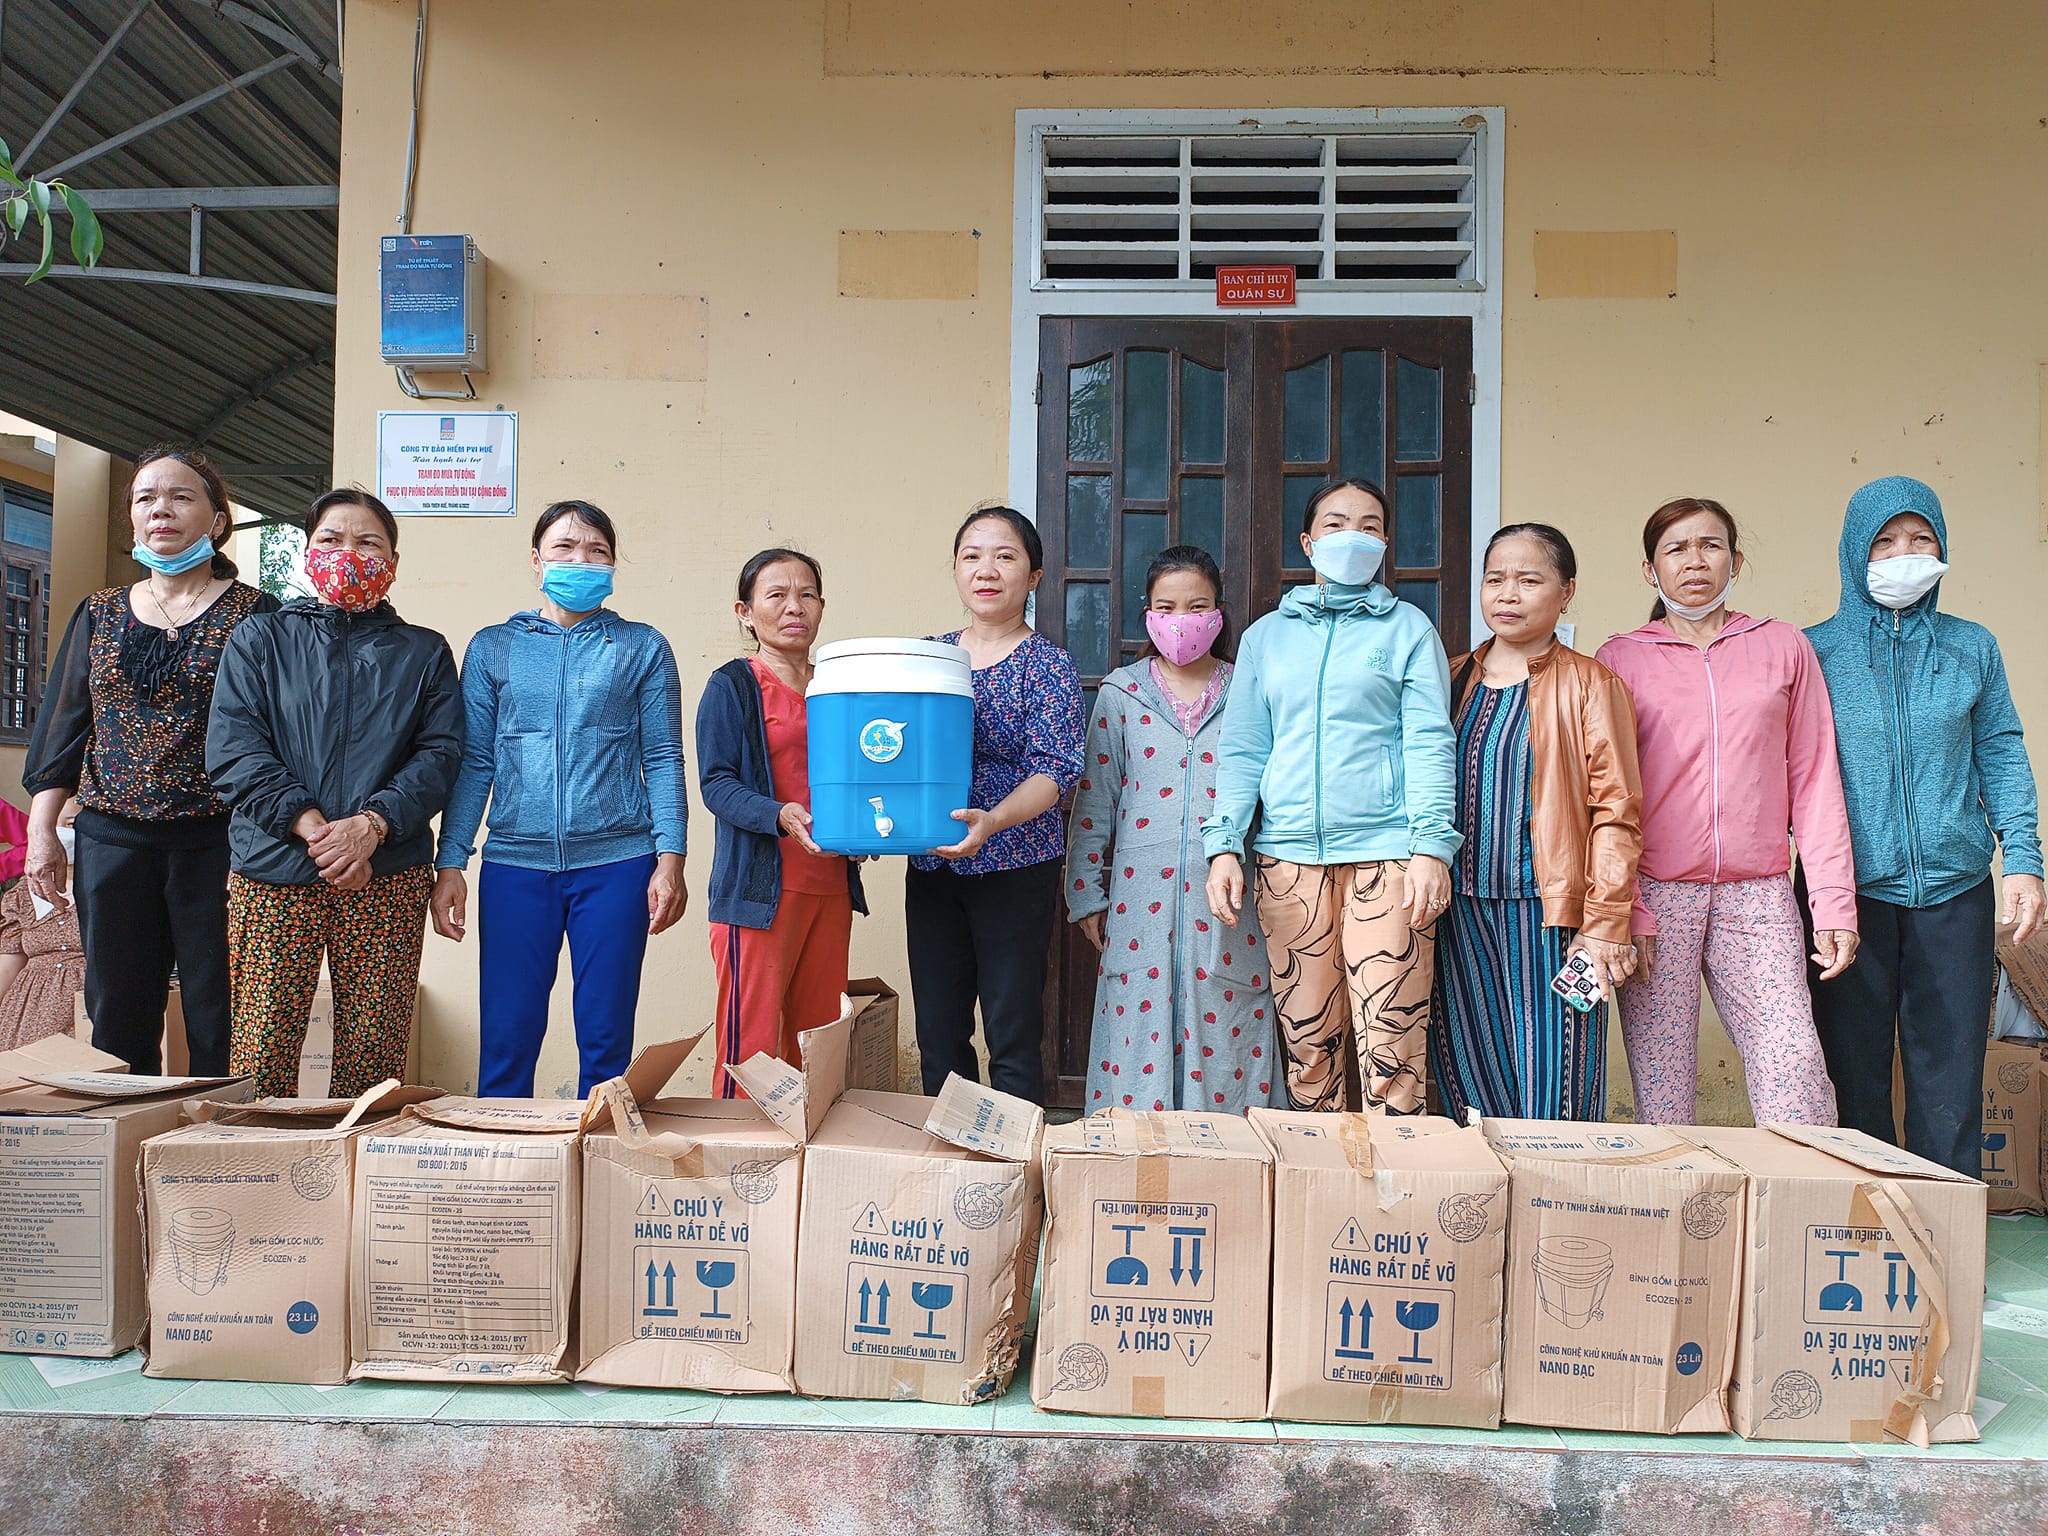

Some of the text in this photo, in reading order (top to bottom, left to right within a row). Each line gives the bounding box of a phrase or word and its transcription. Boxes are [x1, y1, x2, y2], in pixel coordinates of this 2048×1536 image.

[1224, 272, 1288, 284] BAN CHỈ HUY
[1227, 288, 1285, 299] QUÂN SỰ
[401, 445, 419, 453] CÔNG
[1987, 1088, 1995, 1103] Ý
[7, 1125, 40, 1137] THAN VIỆT
[5, 1139, 20, 1147] 2015
[367, 1142, 490, 1159] CÔNG TY TNHH SẢN XUẤT THAN VIỆT
[417, 1160, 428, 1168] ISO
[450, 1161, 467, 1170] 2015
[674, 1195, 723, 1218] CHÚ Ý
[1101, 1203, 1119, 1217] TÊN
[1171, 1204, 1193, 1217] THEO
[1196, 1206, 1208, 1221] ĐỂ
[1531, 1198, 1670, 1220] CÔNG TY TNHH SẢN XUẤT THAN VIỆT
[635, 1218, 749, 1244] HÀNG RẤT DỄ VỠ
[892, 1217, 944, 1239] CHÚ Ý
[1814, 1228, 1832, 1241] TÊN
[1374, 1230, 1429, 1255] CHÚ Ý
[851, 1236, 970, 1267] HÀNG RẤT DỄ VỠ
[1329, 1255, 1456, 1282] HÀNG RẤT DỄ VỠ
[1629, 1273, 1649, 1285] BÌNH
[1652, 1274, 1672, 1286] GỐM
[1646, 1294, 1679, 1305] ECOZEN
[1684, 1296, 1693, 1305] 25
[168, 1311, 273, 1325] CÔNG NGHỆ KHỬ KHUẨN AN TOÀN
[288, 1312, 317, 1322] 23 Lít
[1091, 1304, 1212, 1330] HÀNG RẤT DỄ VỠ
[166, 1327, 213, 1344] NANO BẠC
[491, 1335, 511, 1343] 2015/
[641, 1323, 653, 1337] ĐỂ
[655, 1326, 677, 1338] THEO
[706, 1328, 723, 1341] MŨI
[725, 1328, 742, 1342] TÊN
[491, 1343, 512, 1351] 2021/
[852, 1340, 865, 1354] ĐỂ
[866, 1343, 889, 1356] THEO
[920, 1346, 937, 1359] MŨI
[938, 1347, 956, 1360] TÊN
[1117, 1330, 1171, 1353] CHÚ Ý
[1804, 1331, 1823, 1353] VỠ
[1829, 1332, 1847, 1355] DỄ
[1853, 1333, 1882, 1357] RẤT
[1540, 1344, 1663, 1366] CÔNG NGHỆ KHỬ KHUẨN AN TOÀN
[1676, 1352, 1702, 1363] 23 Lít
[1332, 1364, 1346, 1380] ĐỂ
[1347, 1368, 1372, 1381] THEO
[1404, 1372, 1423, 1386] MŨI
[1425, 1372, 1443, 1387] TÊN
[1539, 1361, 1595, 1378] NANO BẠC
[1831, 1357, 1885, 1381] CHÚ Ý
